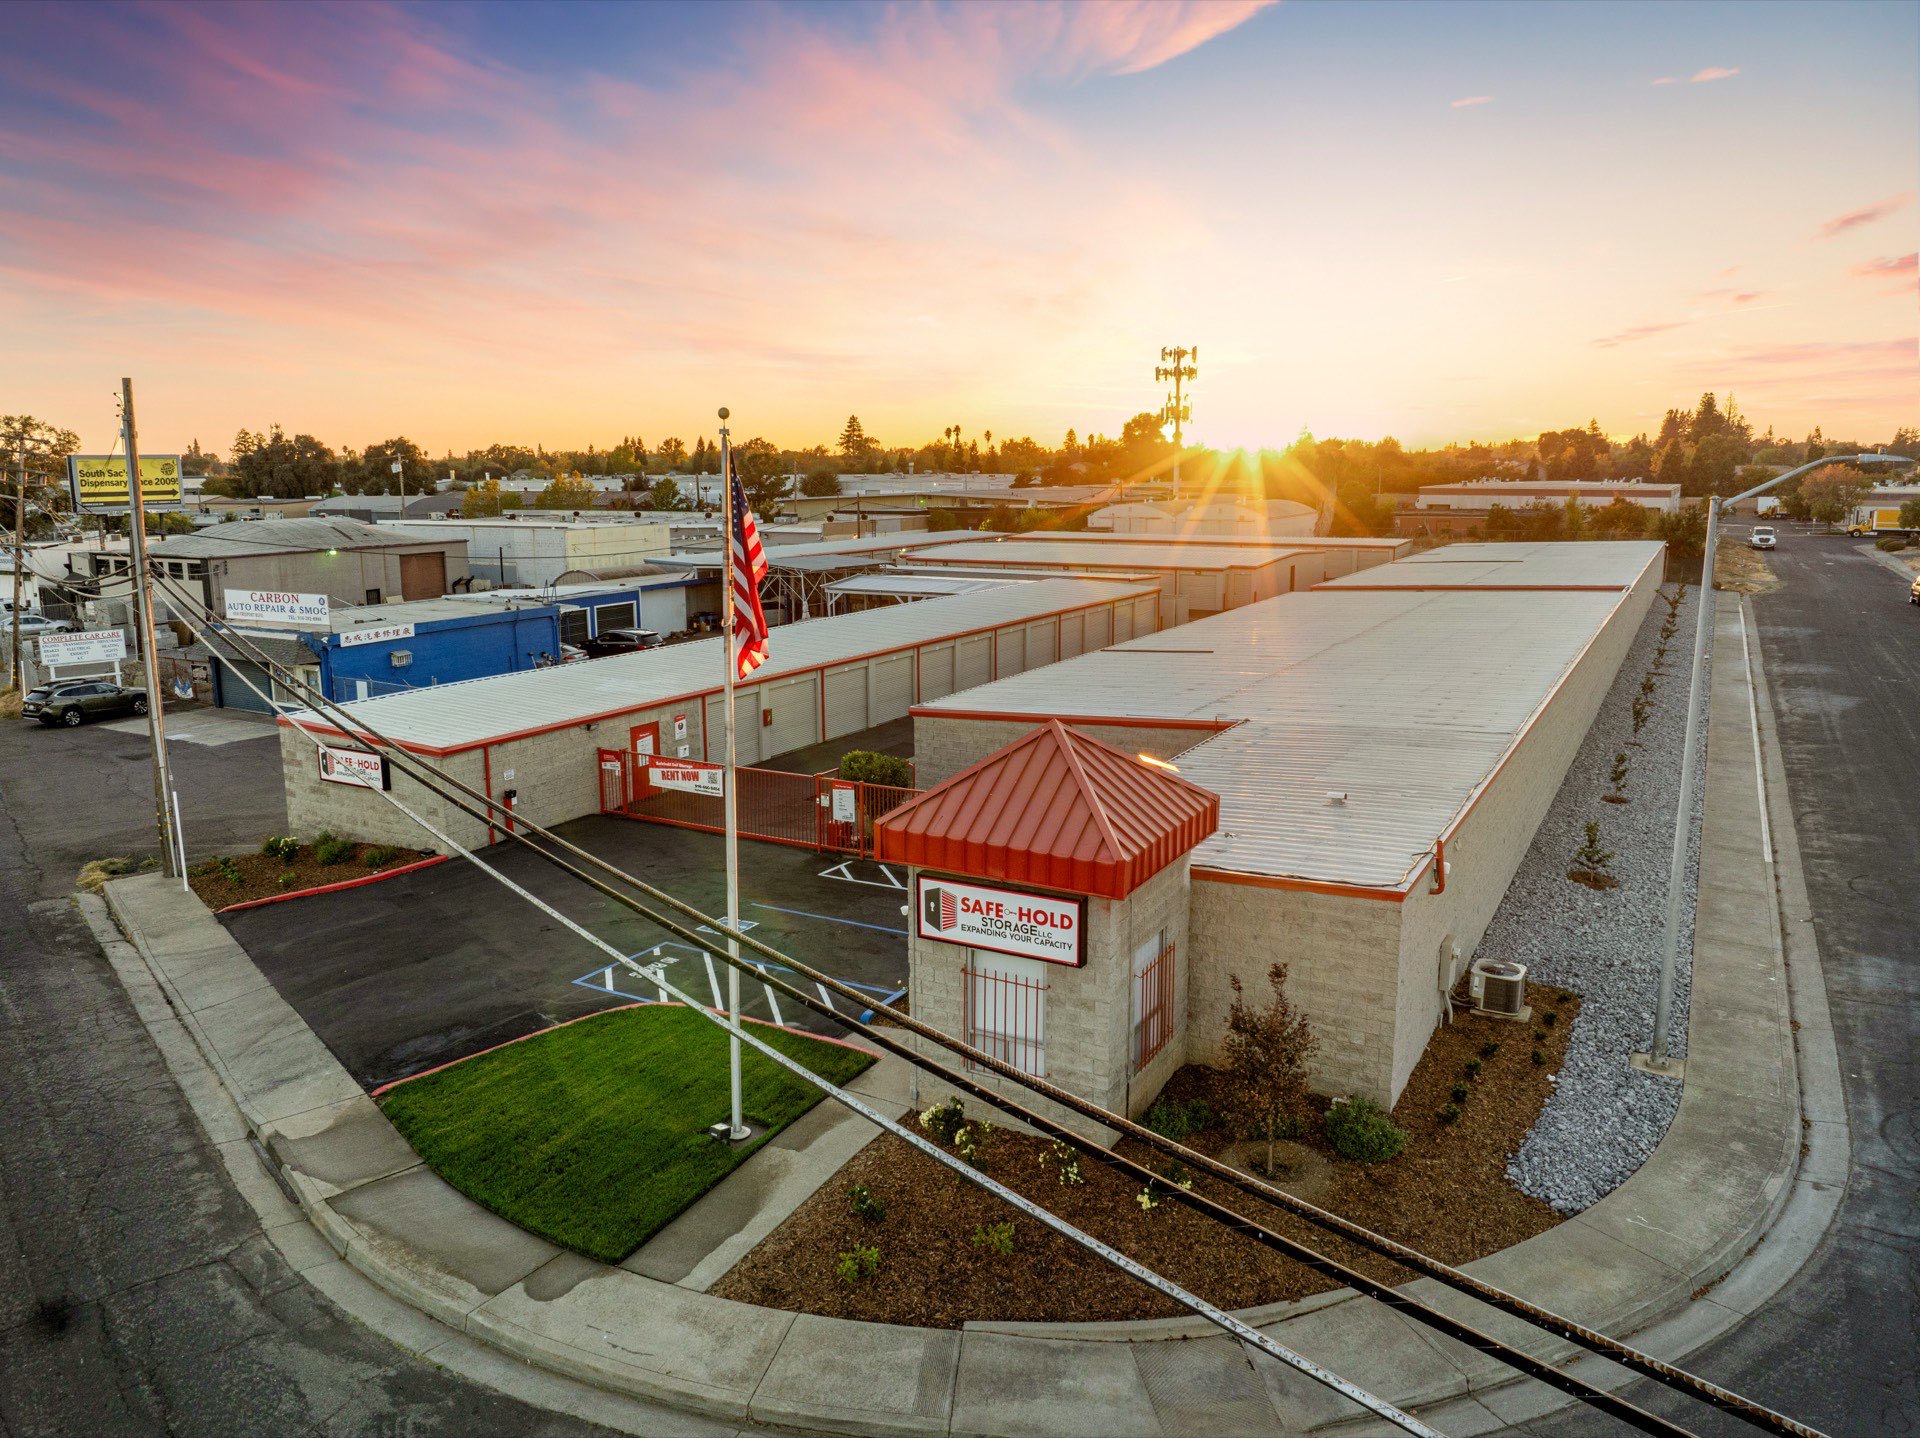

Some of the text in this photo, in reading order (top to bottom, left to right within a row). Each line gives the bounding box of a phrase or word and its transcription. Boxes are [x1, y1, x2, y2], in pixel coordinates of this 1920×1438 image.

[79, 470, 106, 478] South
[80, 480, 128, 488] Dispensary
[155, 478, 179, 486] 2009!
[250, 592, 299, 604] CARBON
[254, 604, 286, 613] REPAIR
[300, 606, 327, 615] SMOG
[42, 634, 82, 643] COMPLETE
[358, 759, 379, 770] HOLD
[661, 770, 699, 781] RENT NOW
[960, 896, 1073, 930] SAFE HOLD
[982, 917, 1052, 939] STORAGE LLC
[961, 924, 1073, 950] EXPANDING YOUR CAPACITY
